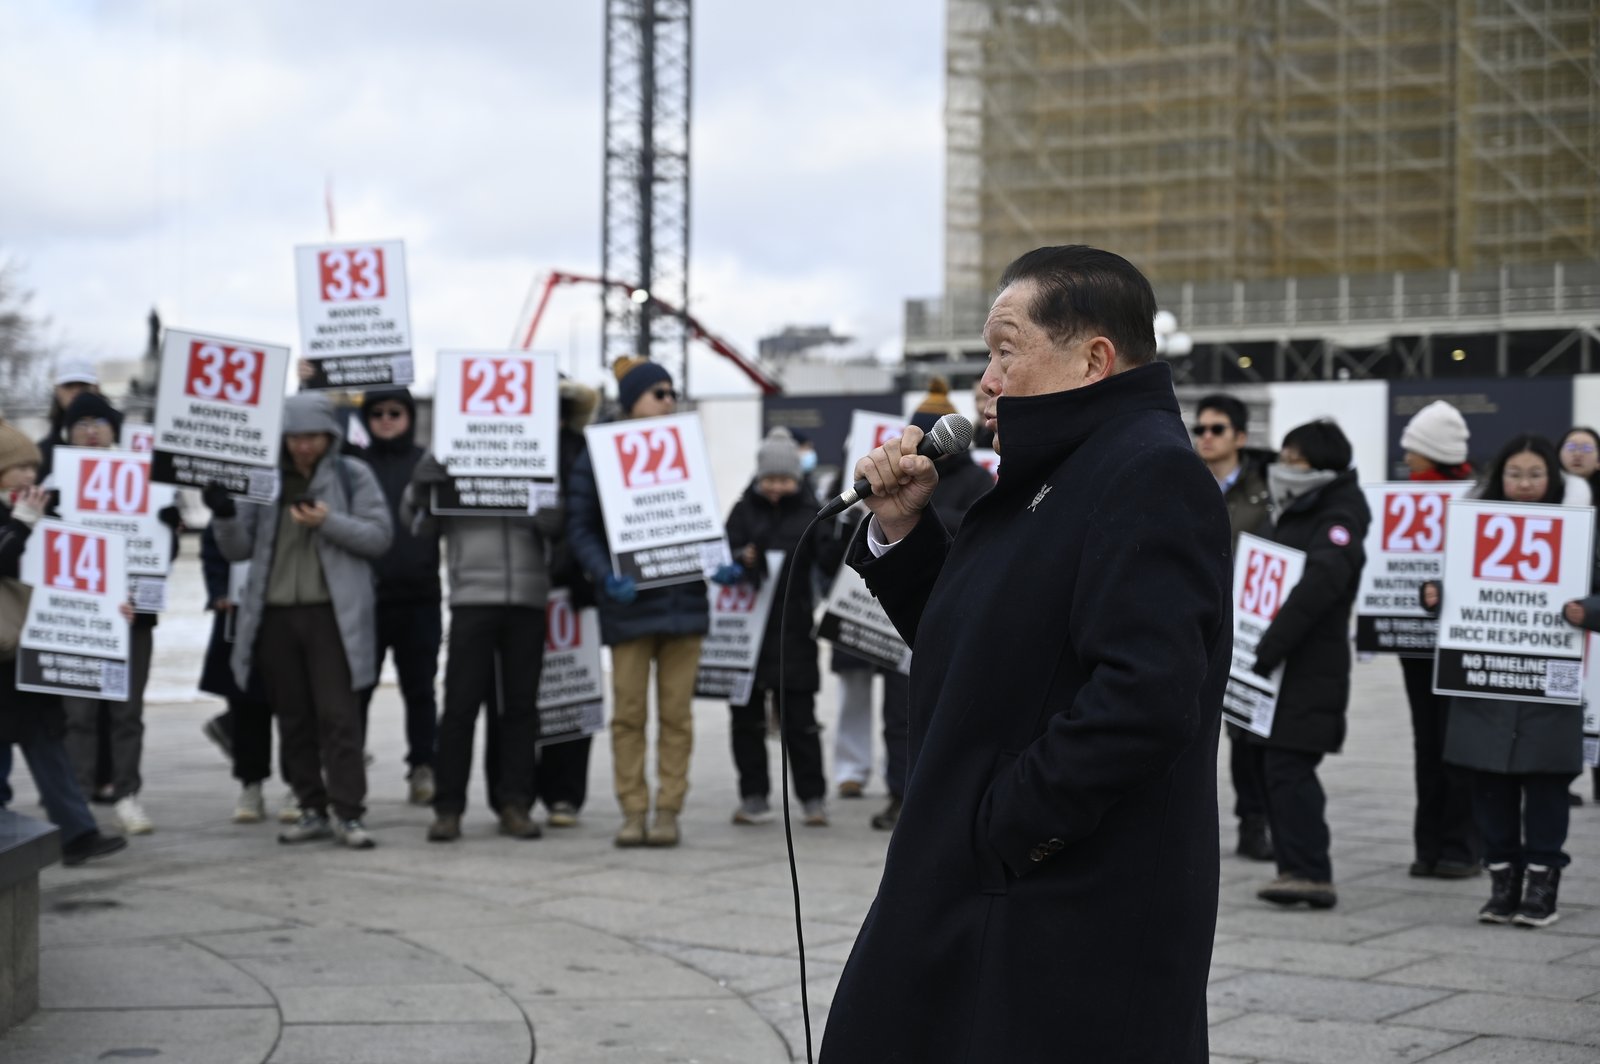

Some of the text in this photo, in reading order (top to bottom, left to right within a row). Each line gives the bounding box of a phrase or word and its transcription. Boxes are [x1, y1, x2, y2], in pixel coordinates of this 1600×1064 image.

[325, 249, 380, 299] 33
[327, 306, 381, 319] MONTHS
[315, 322, 367, 335] WAITING
[192, 343, 256, 403] 33
[466, 359, 527, 413] 23
[190, 404, 248, 423] MONTHS
[172, 418, 262, 441] WAITING FOR
[467, 422, 524, 434] MONTHS
[194, 438, 269, 458] RESPONSE
[452, 440, 539, 451] WAITING FOR
[475, 457, 546, 468] RESPONSE
[622, 428, 685, 485] 22
[83, 460, 144, 513] 40
[1388, 494, 1442, 552] 23
[1480, 515, 1554, 583] 25
[53, 531, 102, 592] 14
[1387, 560, 1440, 573] MONTHS
[1244, 553, 1281, 618] 36
[48, 595, 99, 612] MONTHS
[1479, 588, 1548, 607] MONTHS
[36, 611, 112, 630] WAITING FOR
[1460, 606, 1565, 628] WAITING FOR
[57, 632, 120, 649] RESPONSE
[1449, 626, 1574, 648] IRCC RESPONSE
[1462, 654, 1482, 669] NO
[1467, 670, 1547, 690] NO RESULTS
